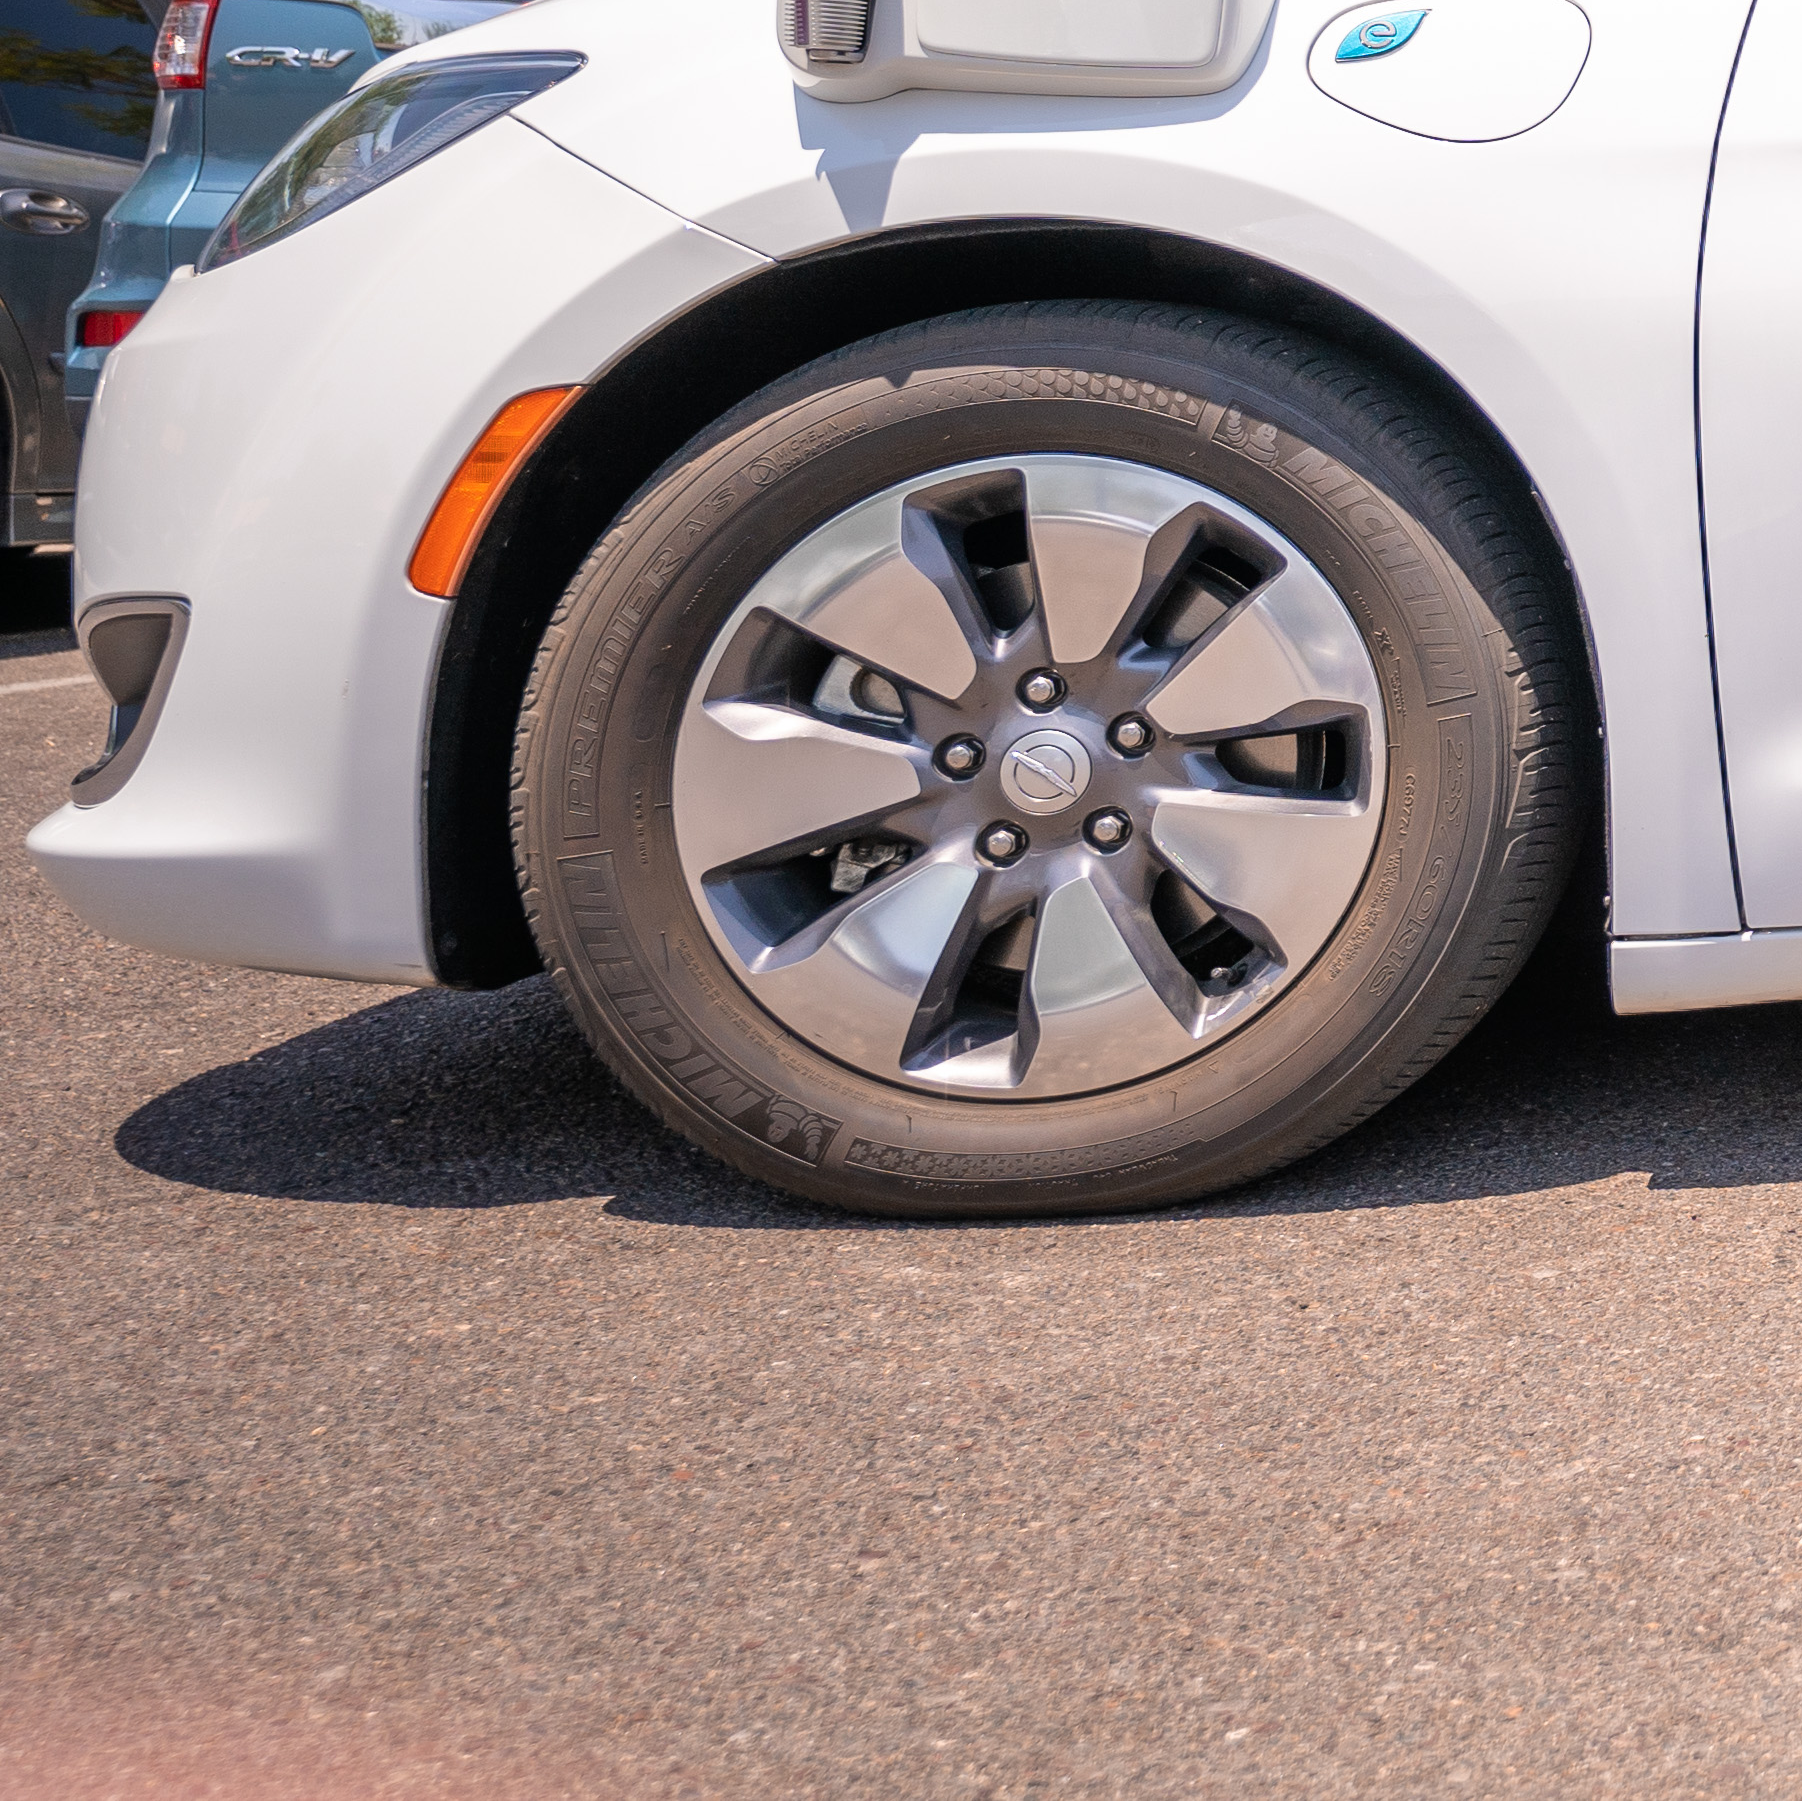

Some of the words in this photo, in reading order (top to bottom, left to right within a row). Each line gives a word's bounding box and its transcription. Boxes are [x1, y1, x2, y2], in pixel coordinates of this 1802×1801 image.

[226, 45, 356, 69] CR-V
[774, 422, 839, 462] MICHELIN
[567, 547, 685, 817] PREMIER
[1283, 446, 1470, 689] MICHELIN
[562, 861, 764, 1118] MICHELIN
[1368, 739, 1465, 998] 235/60R18
